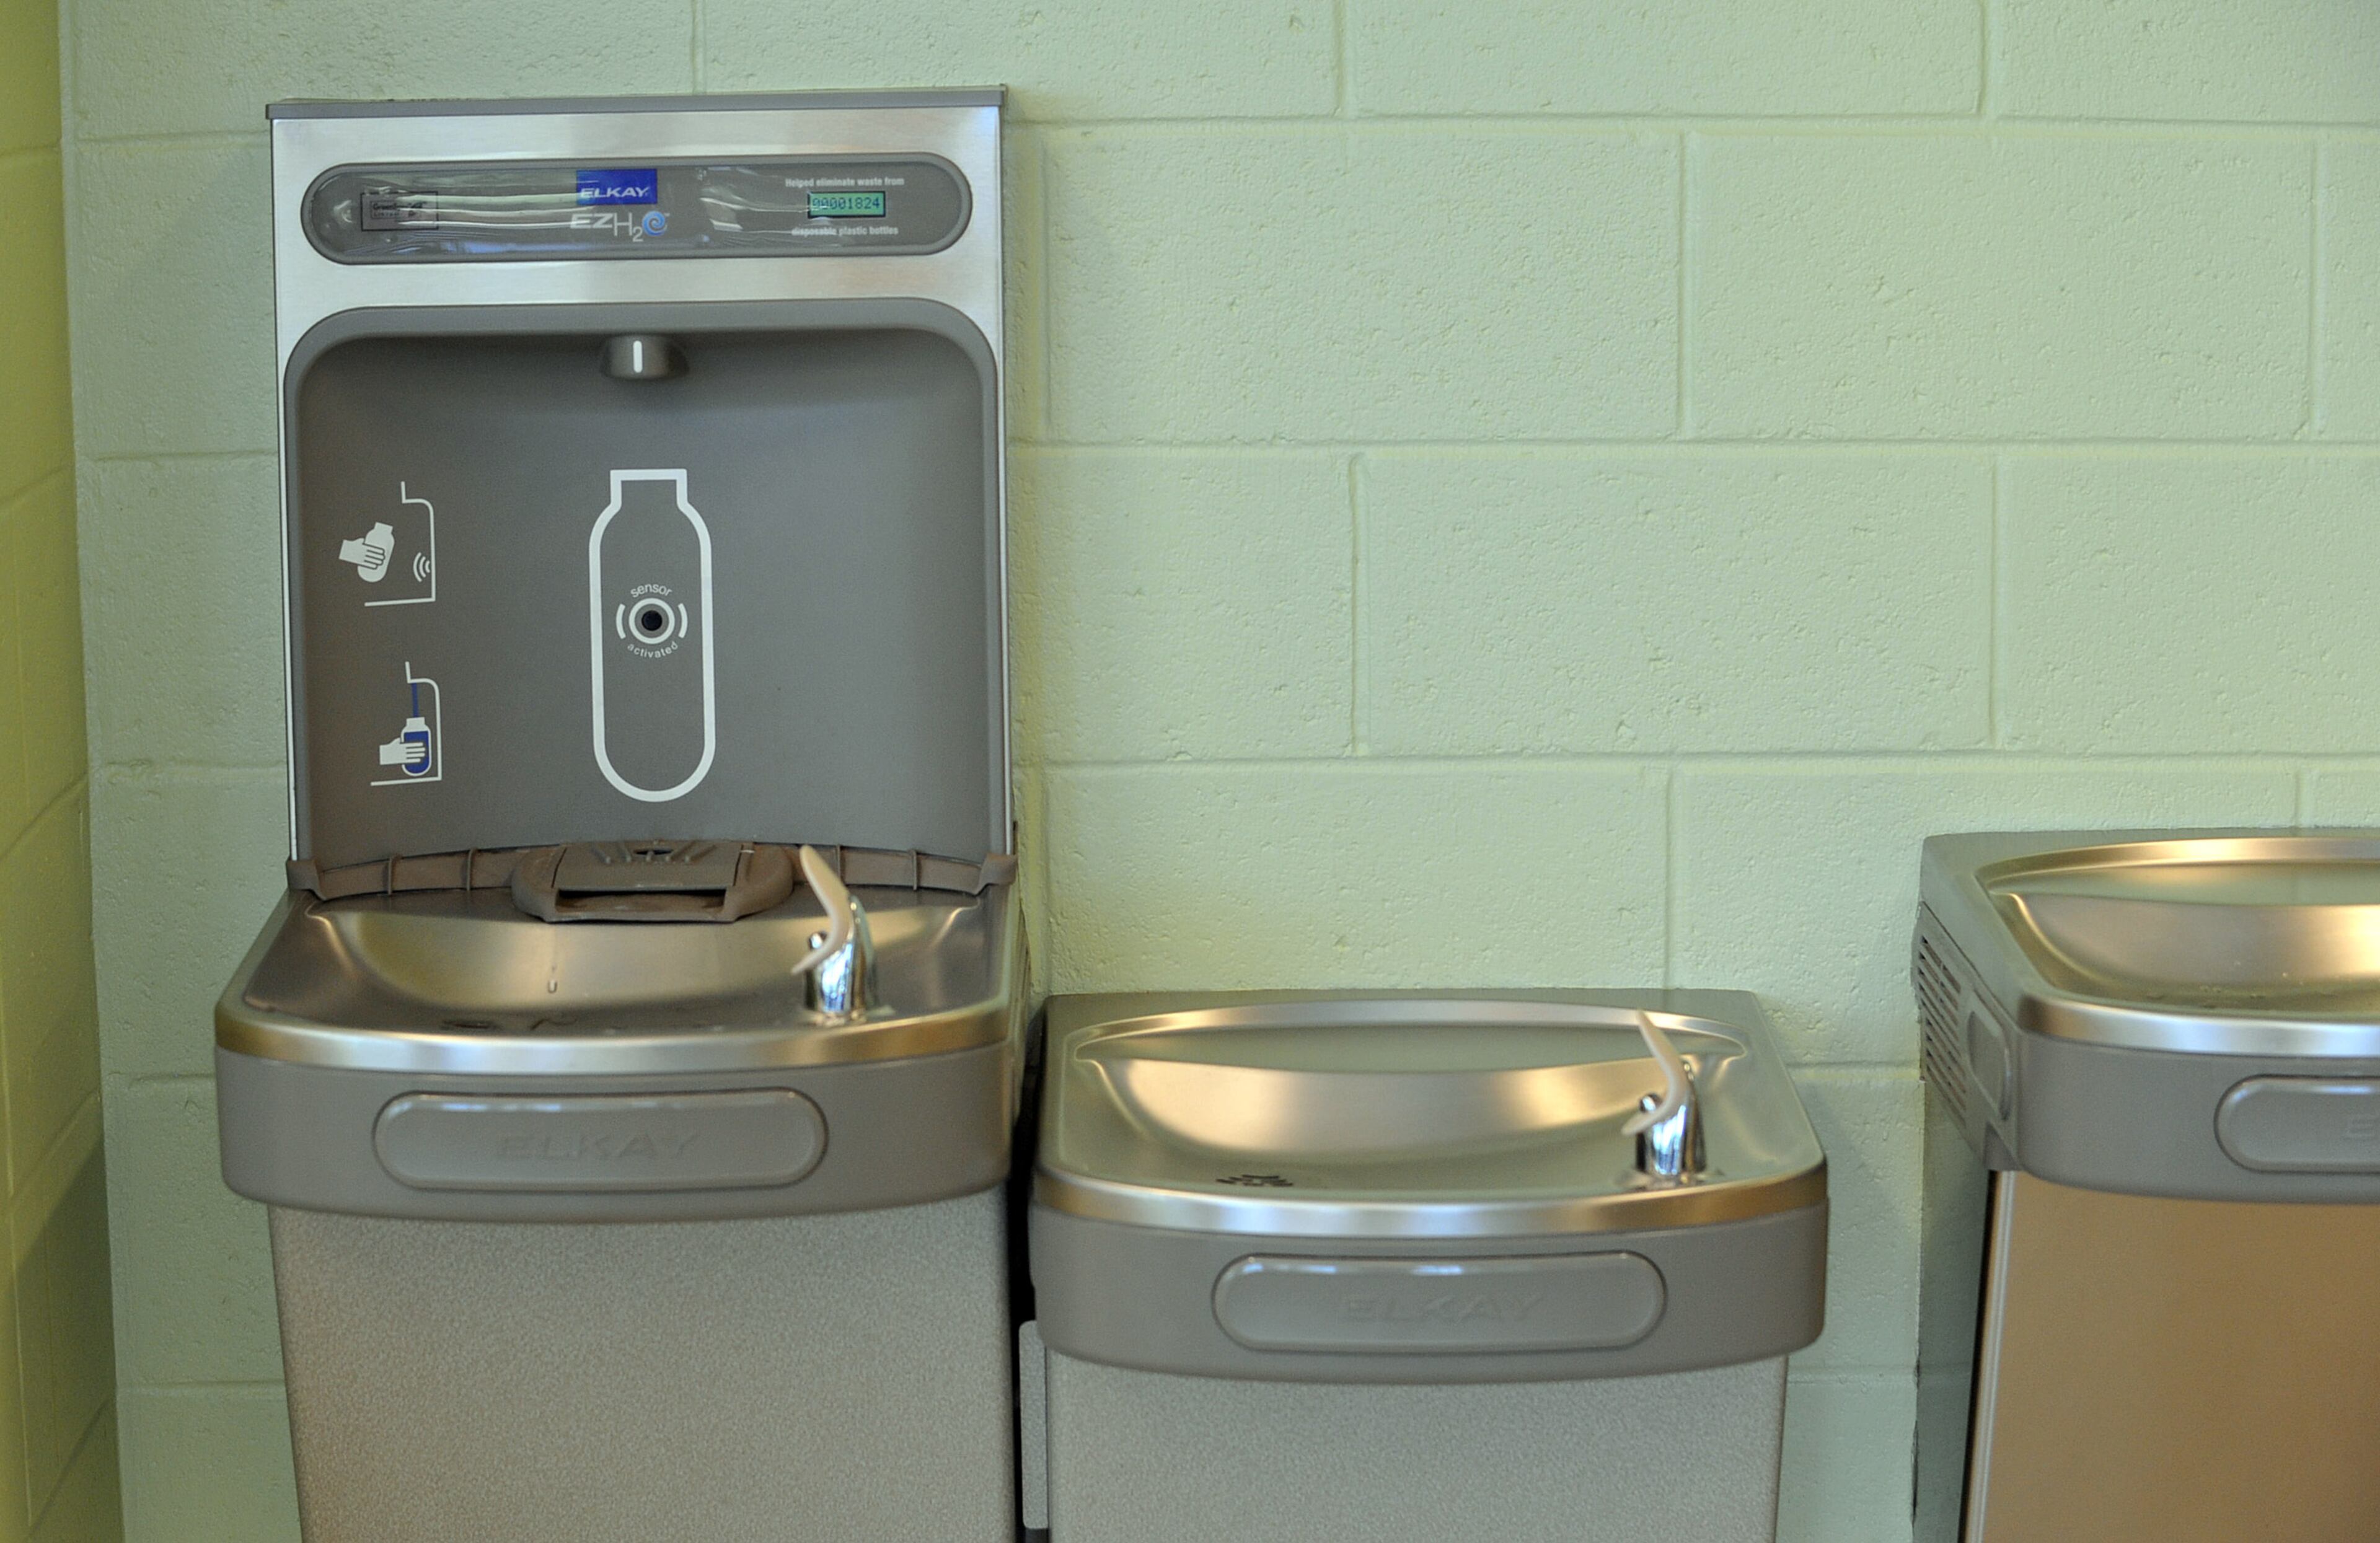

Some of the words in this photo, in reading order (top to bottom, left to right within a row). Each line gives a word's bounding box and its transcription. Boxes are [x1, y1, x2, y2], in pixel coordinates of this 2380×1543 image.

[785, 178, 814, 188] Helped
[816, 177, 855, 186] eliminate
[857, 177, 883, 186] waste
[884, 177, 904, 186] from
[581, 187, 649, 198] ELKAY
[791, 227, 837, 237] disposable
[839, 226, 866, 237] plastic
[869, 226, 899, 235] bottles
[630, 584, 672, 598] sensor
[627, 641, 678, 658] activated
[498, 1131, 702, 1161] ELKAY
